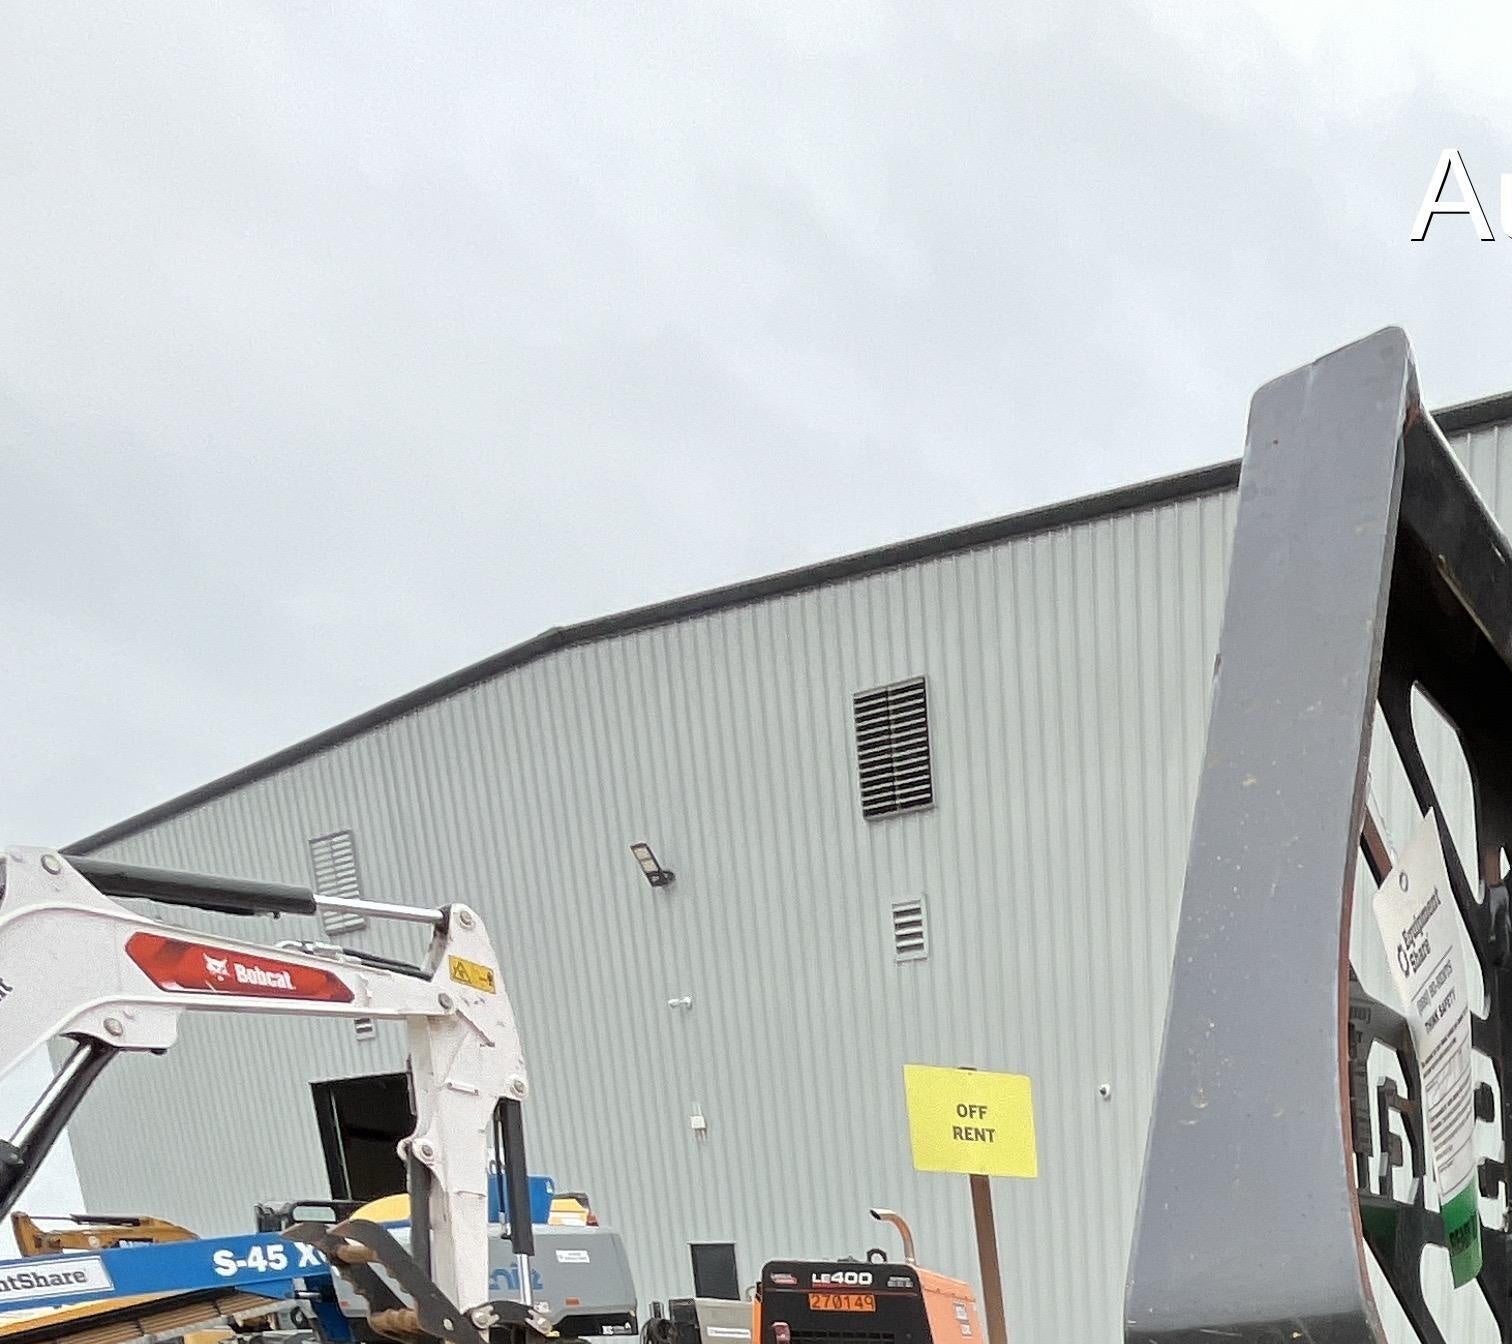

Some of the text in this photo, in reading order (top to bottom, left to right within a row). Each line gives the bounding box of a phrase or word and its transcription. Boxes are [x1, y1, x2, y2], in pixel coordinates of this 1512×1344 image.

[1402, 885, 1441, 949] Equipment
[1409, 938, 1431, 973] Share
[233, 963, 296, 990] Bobcat
[956, 1103, 988, 1120] OFF
[952, 1125, 996, 1143] RENT
[213, 1240, 328, 1277] S-45 X
[811, 1271, 873, 1285] LE400
[810, 1294, 874, 1310] 270149
